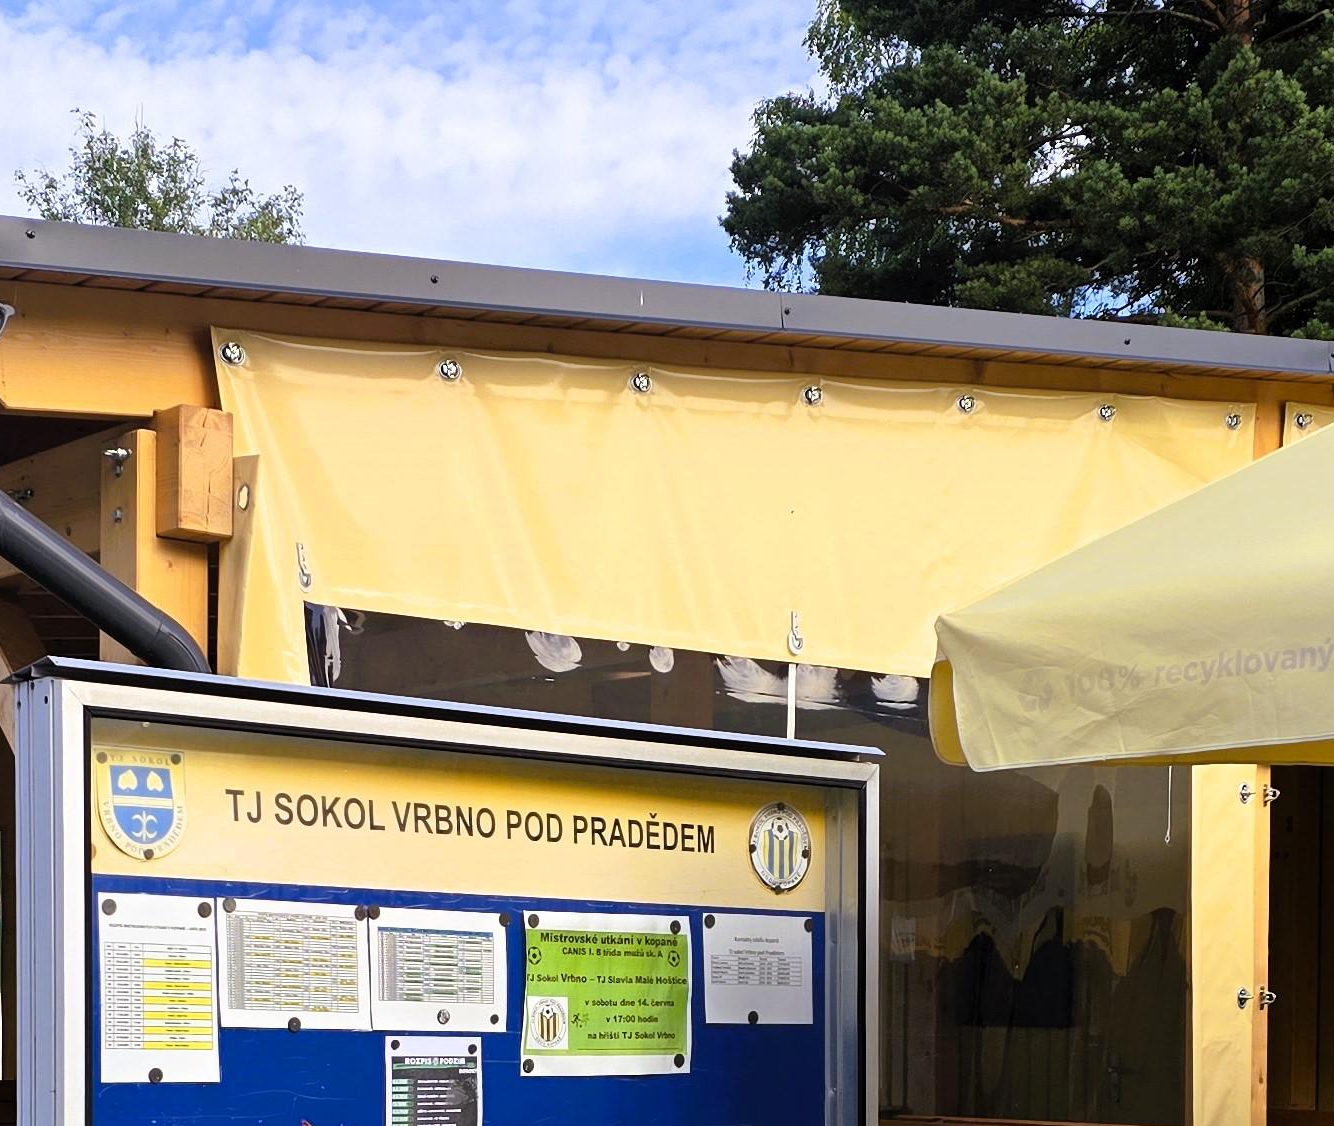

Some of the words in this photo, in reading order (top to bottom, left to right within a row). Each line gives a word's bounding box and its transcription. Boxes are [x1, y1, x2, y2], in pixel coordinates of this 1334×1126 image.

[1066, 663, 1146, 699] 100%
[225, 788, 262, 823] TJ
[274, 792, 386, 831] SOKOL
[391, 800, 496, 839] VRBNO
[506, 809, 563, 843] POD
[572, 812, 715, 854] PRADĚDEM
[540, 932, 598, 944] Mistrovské
[601, 934, 634, 945] utkání
[636, 937, 642, 945] v
[644, 935, 678, 947] kopané
[562, 947, 586, 956] CANIS
[537, 974, 559, 983] Sokol
[561, 973, 587, 983] Vrbno
[597, 976, 606, 984] TJ
[608, 976, 633, 984] Slavia
[655, 976, 688, 985] Hoštice
[613, 1015, 635, 1023] 17:00
[622, 1032, 632, 1040] TJ
[634, 1032, 655, 1040] Sokol
